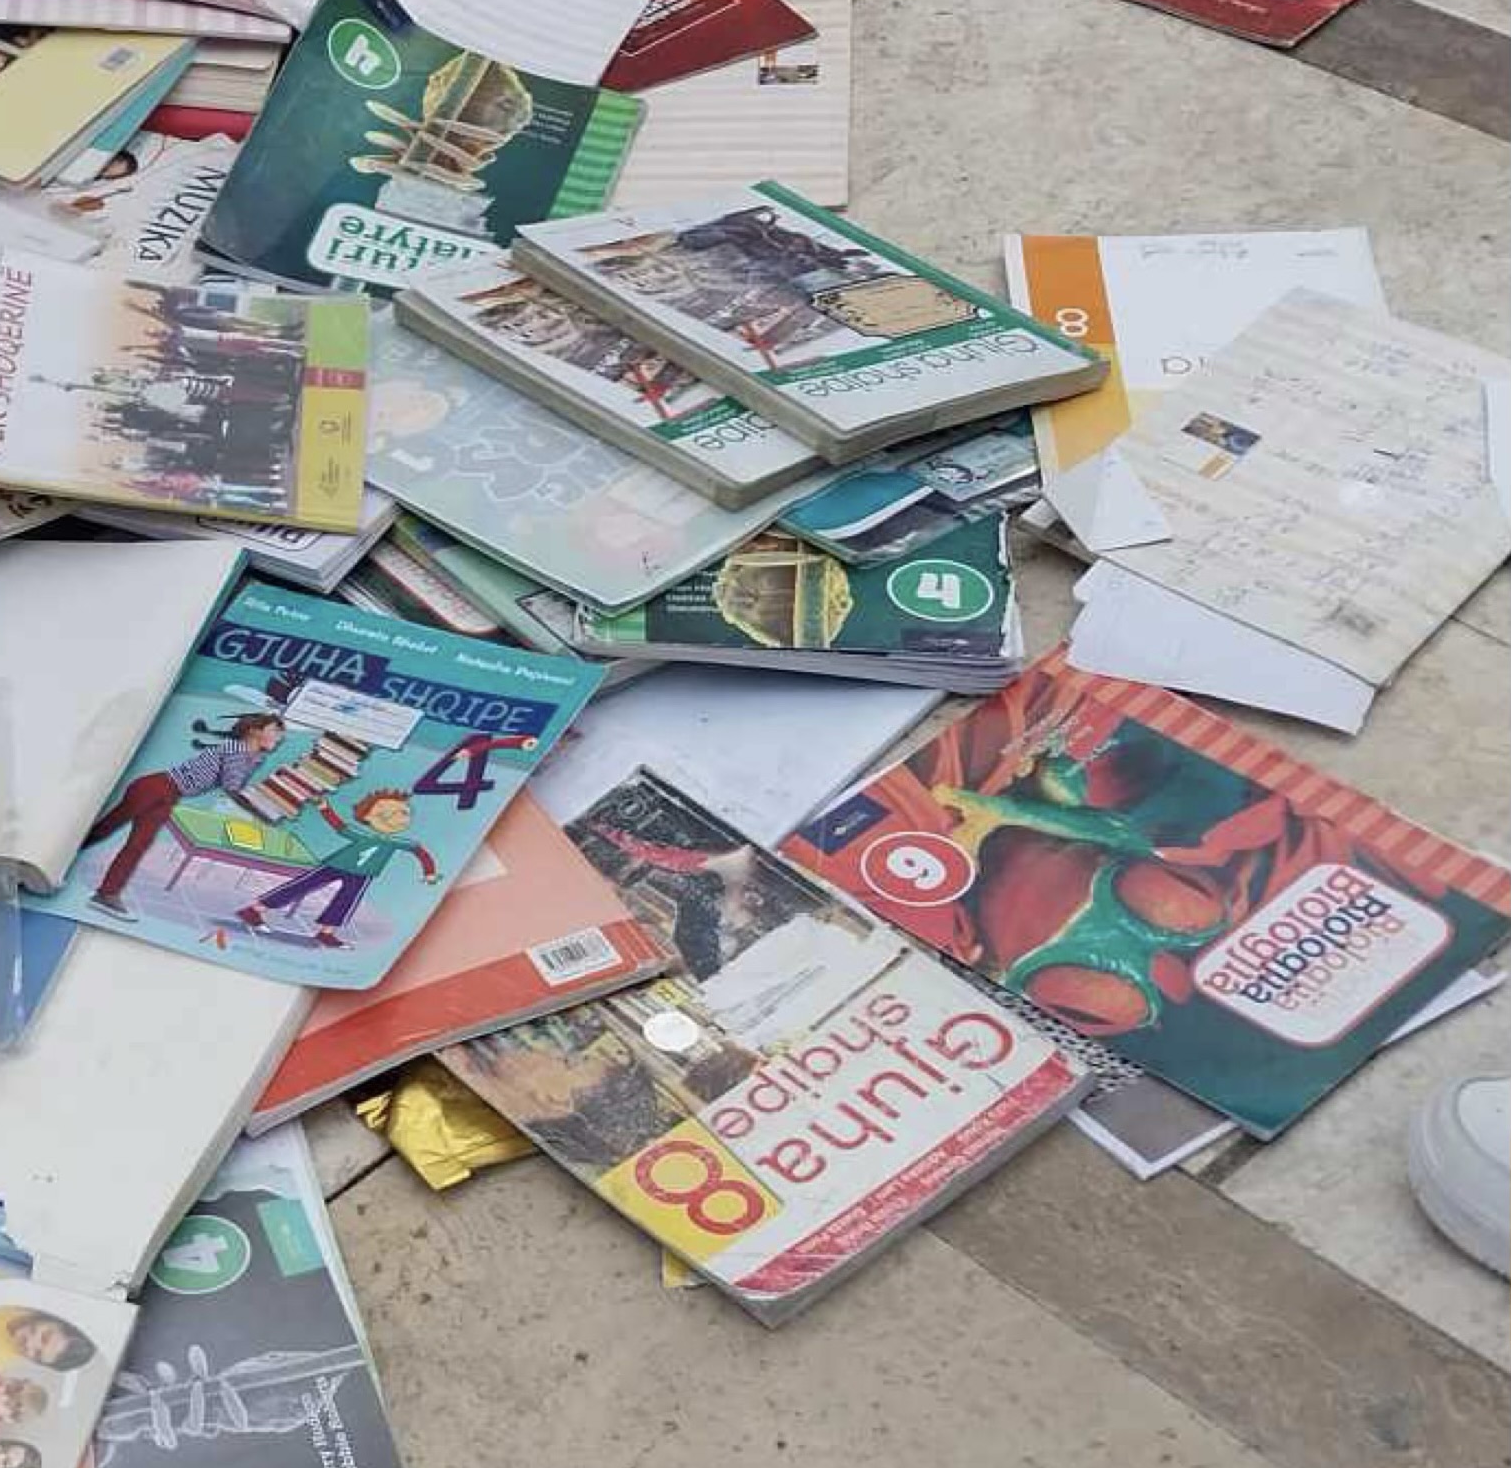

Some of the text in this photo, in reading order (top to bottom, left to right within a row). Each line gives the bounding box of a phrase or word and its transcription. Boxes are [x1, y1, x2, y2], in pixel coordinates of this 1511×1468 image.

[138, 165, 227, 262] MUZIKA
[1057, 307, 1089, 337] 8
[212, 628, 533, 734] GJUHA SHQIPE
[413, 735, 494, 811] 4
[710, 993, 912, 1141] shqipe
[754, 1012, 1015, 1185] Gjuha
[634, 1139, 767, 1236] 8
